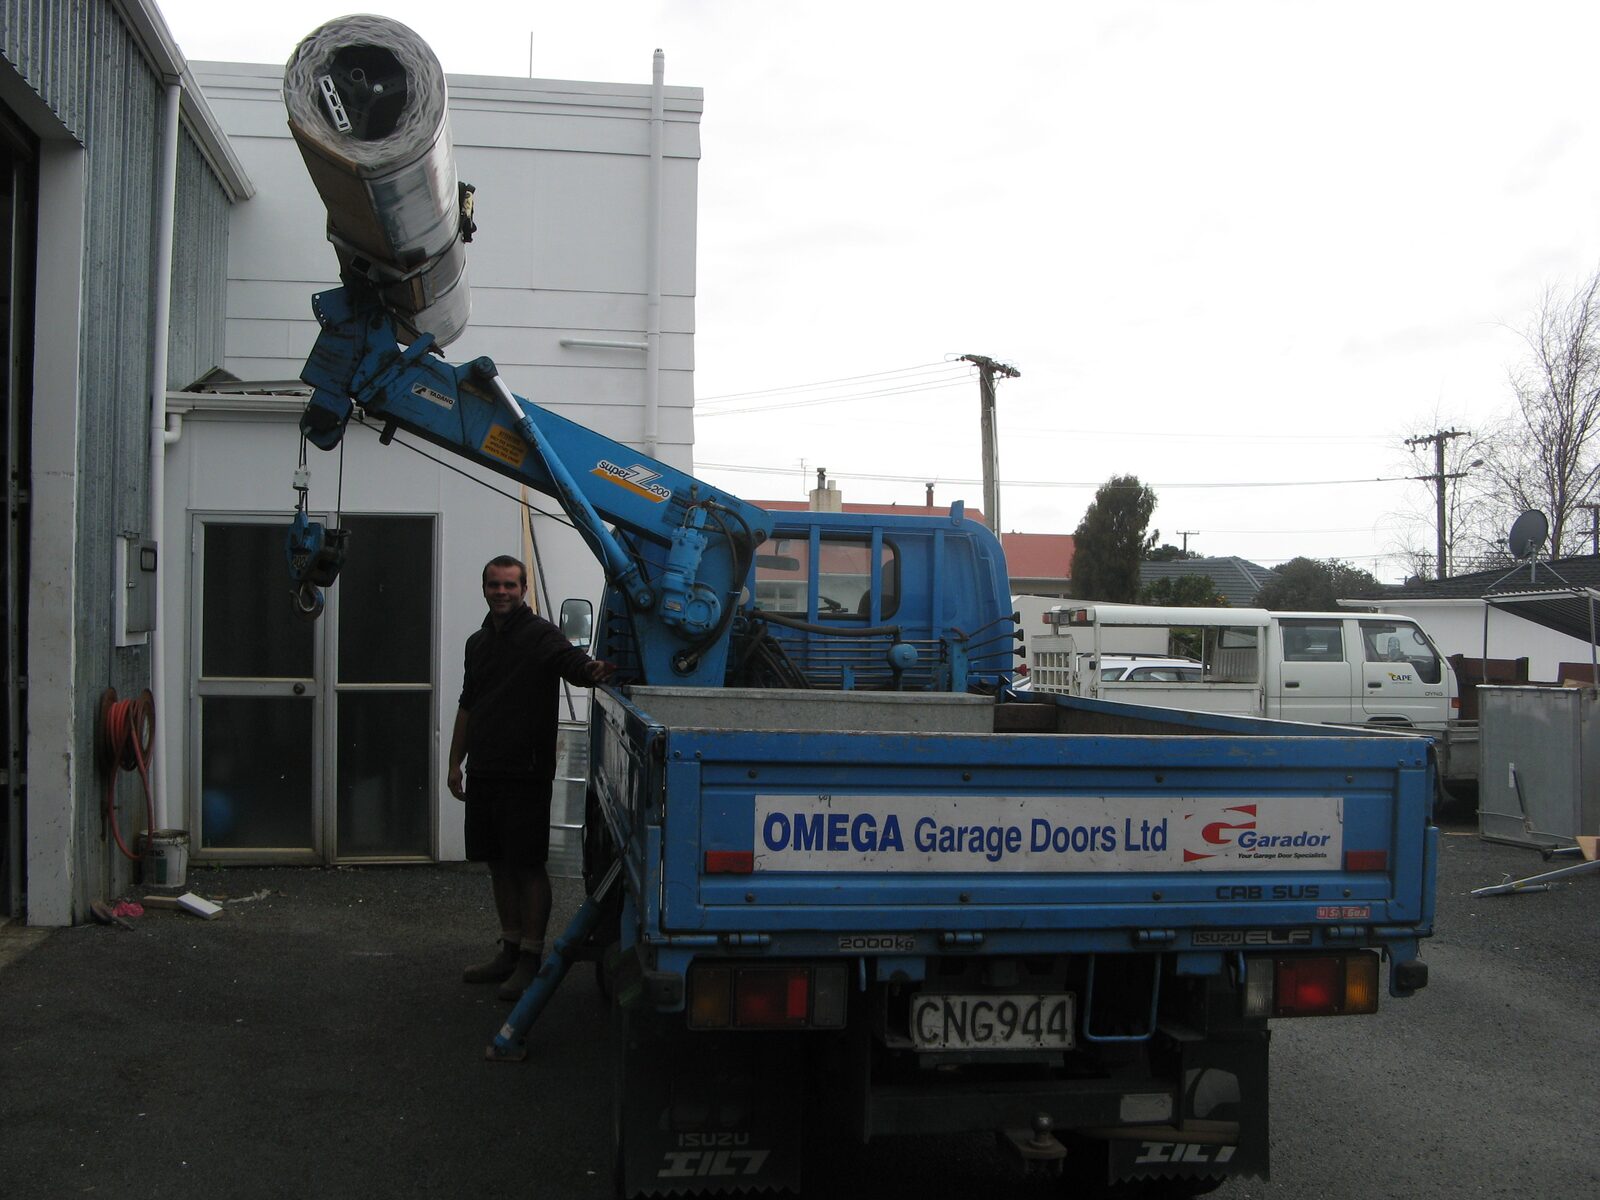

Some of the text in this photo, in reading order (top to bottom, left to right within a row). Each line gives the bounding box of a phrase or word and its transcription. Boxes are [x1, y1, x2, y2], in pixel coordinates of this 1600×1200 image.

[430, 390, 454, 405] TADANO
[599, 461, 630, 479] super
[650, 485, 670, 498] 200
[763, 812, 1167, 862] OMEGA Garage Doors Ltd
[1238, 831, 1331, 849] Garador
[1253, 852, 1277, 860] Garage
[1215, 885, 1320, 900] CAB SUS
[839, 936, 915, 950] 2000kg
[1195, 930, 1311, 945] ISUZU ELF
[916, 1000, 1070, 1044] CNG944
[678, 1132, 749, 1147] ISUZU
